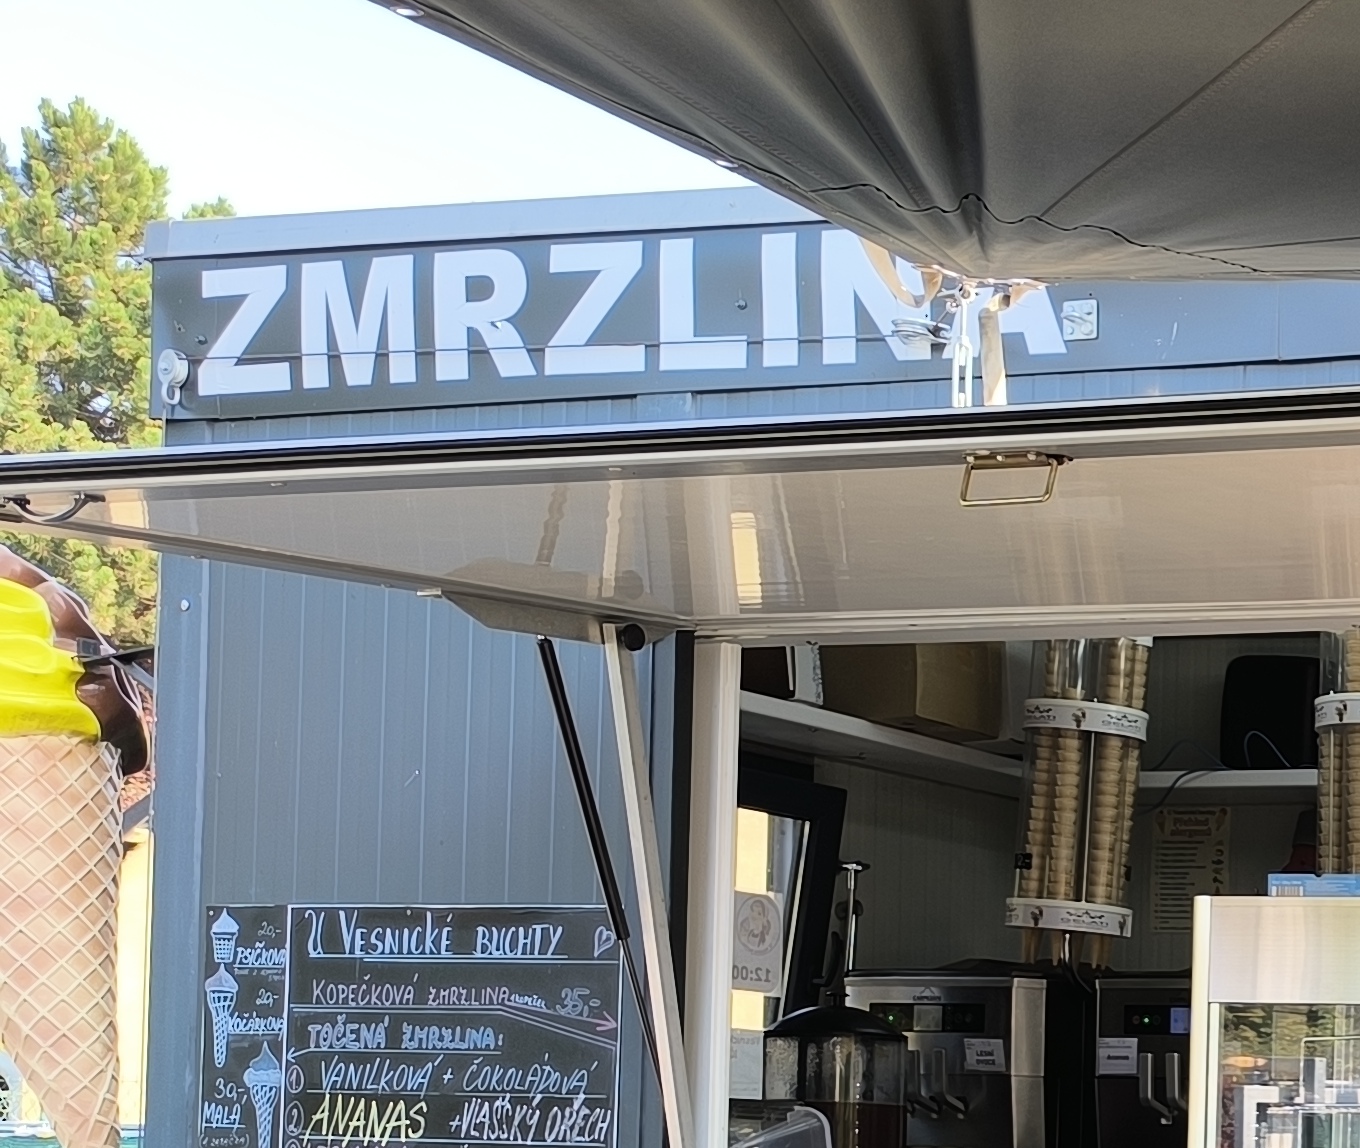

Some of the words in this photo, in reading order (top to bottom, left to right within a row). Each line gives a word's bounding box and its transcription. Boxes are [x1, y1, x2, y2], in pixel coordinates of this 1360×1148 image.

[339, 910, 454, 955] VESNICKÉ
[472, 924, 564, 956] BUCHTY
[312, 974, 418, 1005] KOPEČKOVÁ
[307, 1014, 390, 1048] TOČENÁ
[321, 1055, 444, 1098] VANILKOVÁ
[304, 1093, 428, 1147] ANANAS
